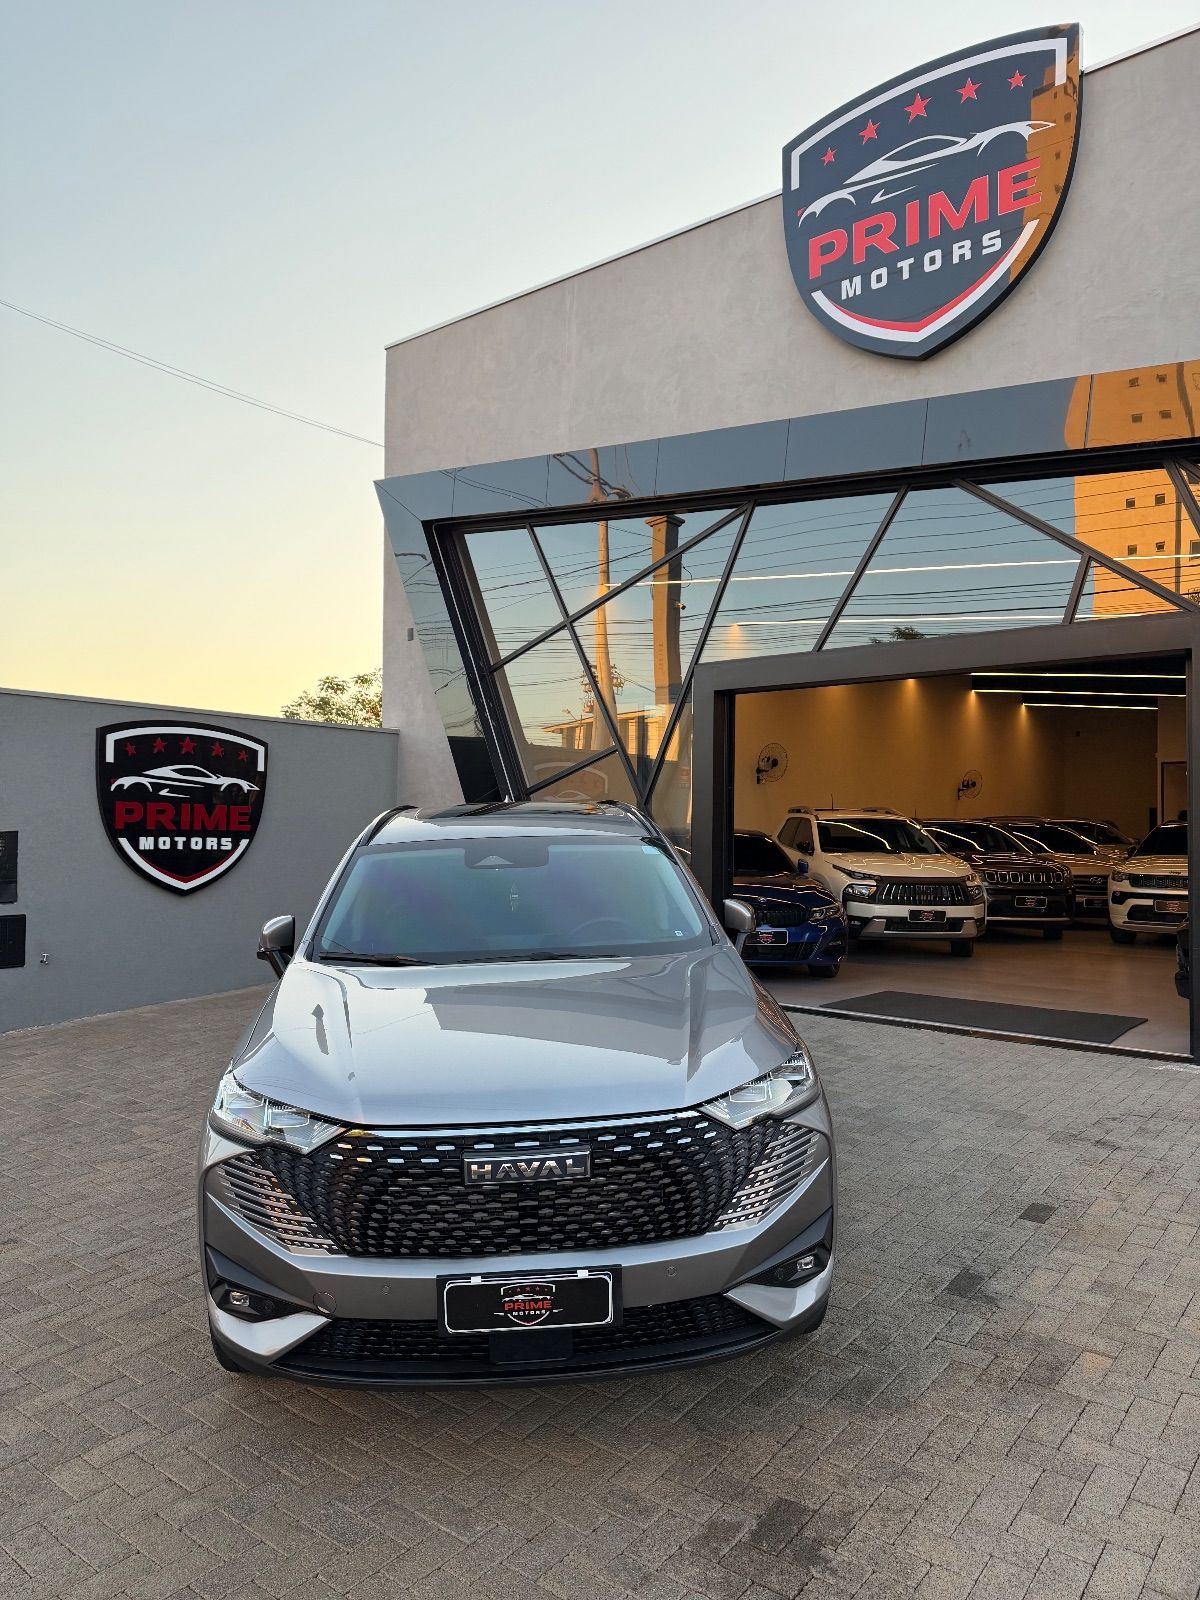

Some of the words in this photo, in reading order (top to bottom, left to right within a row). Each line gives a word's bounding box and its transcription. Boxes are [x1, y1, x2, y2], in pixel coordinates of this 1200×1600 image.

[808, 157, 1041, 280] PRIME
[841, 230, 1002, 300] MOTORS
[115, 801, 252, 831] PRIME
[139, 836, 233, 850] MOTORS
[470, 1158, 584, 1180] HAVAL
[504, 1301, 552, 1311] PRIME
